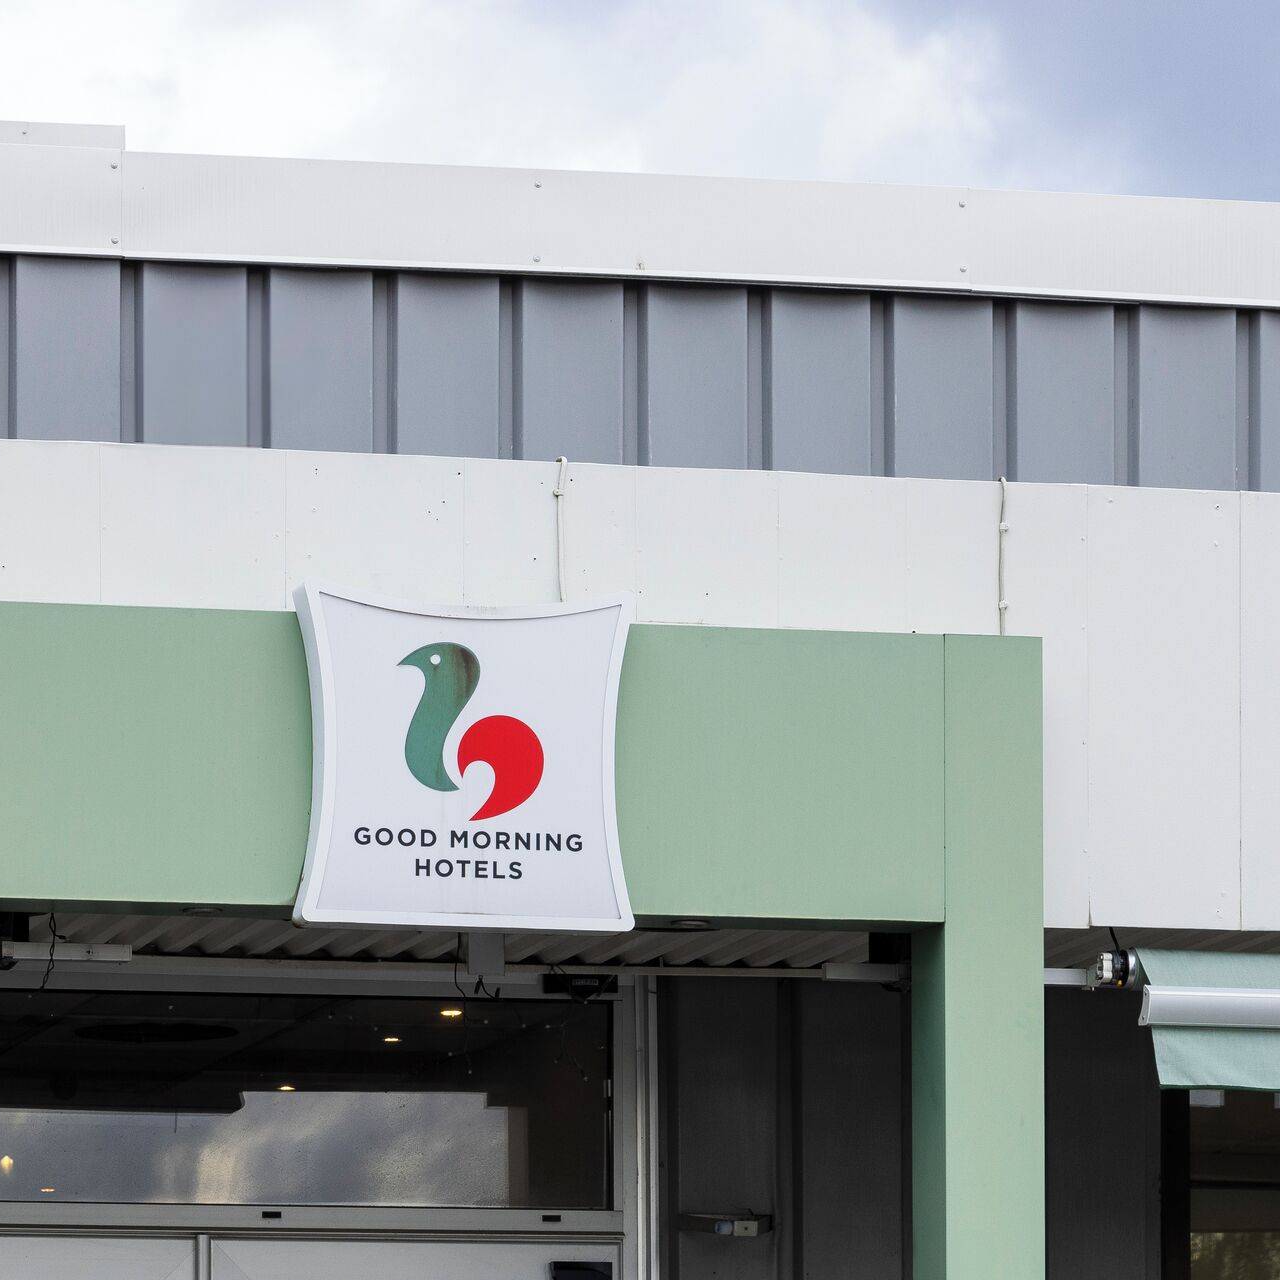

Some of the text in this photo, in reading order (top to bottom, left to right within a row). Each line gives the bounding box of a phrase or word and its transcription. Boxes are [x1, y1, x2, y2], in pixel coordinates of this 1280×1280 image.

[354, 827, 583, 852] GOOD MORNING
[415, 858, 523, 879] HOTELS
